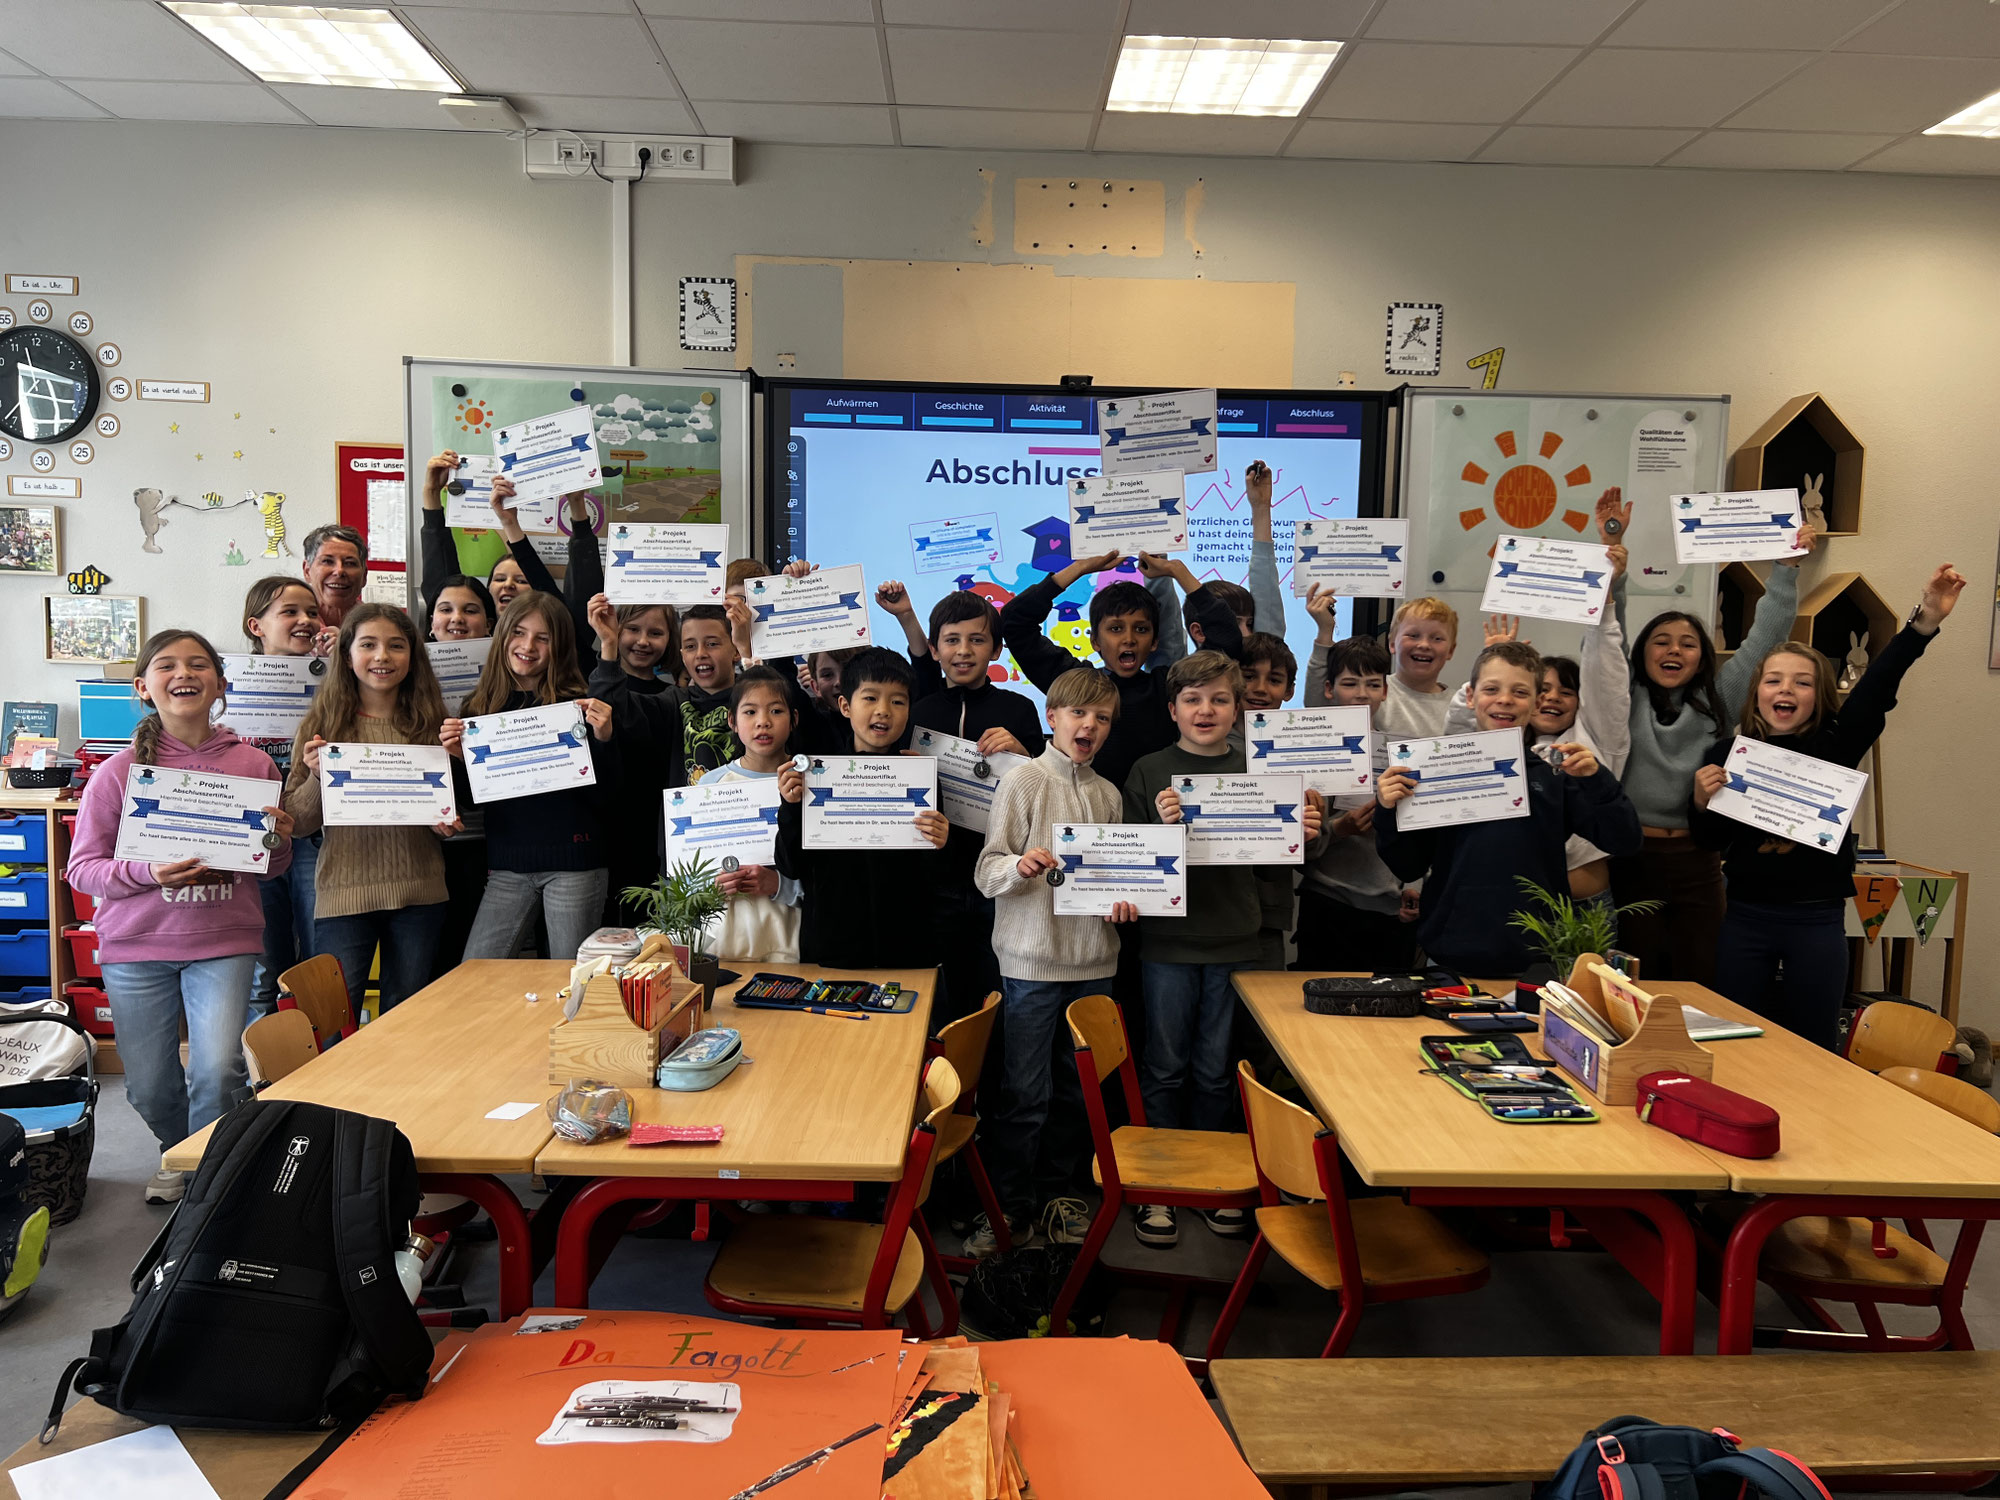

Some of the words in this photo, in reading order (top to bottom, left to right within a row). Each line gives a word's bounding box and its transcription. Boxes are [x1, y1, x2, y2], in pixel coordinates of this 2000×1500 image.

[32, 307, 47, 316] :00
[73, 319, 88, 329] :05
[32, 338, 40, 346] 12
[11, 344, 19, 352] 11
[56, 346, 60, 354] 1
[102, 350, 114, 359] :10
[69, 361, 75, 370] 2
[75, 383, 81, 391] 3
[112, 385, 124, 394] :15
[182, 387, 197, 395] nach
[826, 398, 879, 408] Aufwärmen
[935, 401, 984, 411] Geschichte
[1152, 401, 1175, 409] Projekt
[1029, 403, 1066, 413] Aktivität
[1290, 409, 1334, 418] Abschluss
[12, 416, 18, 424] 7
[101, 421, 114, 430] :20
[535, 421, 555, 432] Projekt
[74, 448, 88, 457] :25
[35, 456, 49, 466] :30
[1120, 480, 1143, 488] Projekt
[1197, 542, 1244, 551] gemacht
[1193, 553, 1224, 562] iheart
[799, 577, 822, 586] Projekt
[514, 716, 538, 725] Projekt
[1448, 742, 1475, 751] Projekt
[864, 764, 890, 772] Projekt
[199, 780, 229, 790] Projekt
[172, 788, 235, 800] Abschlusszertifikat
[162, 884, 233, 902] EARTH
[1867, 878, 1884, 902] E
[1918, 879, 1939, 903] N
[667, 1331, 807, 1380] Fagott
